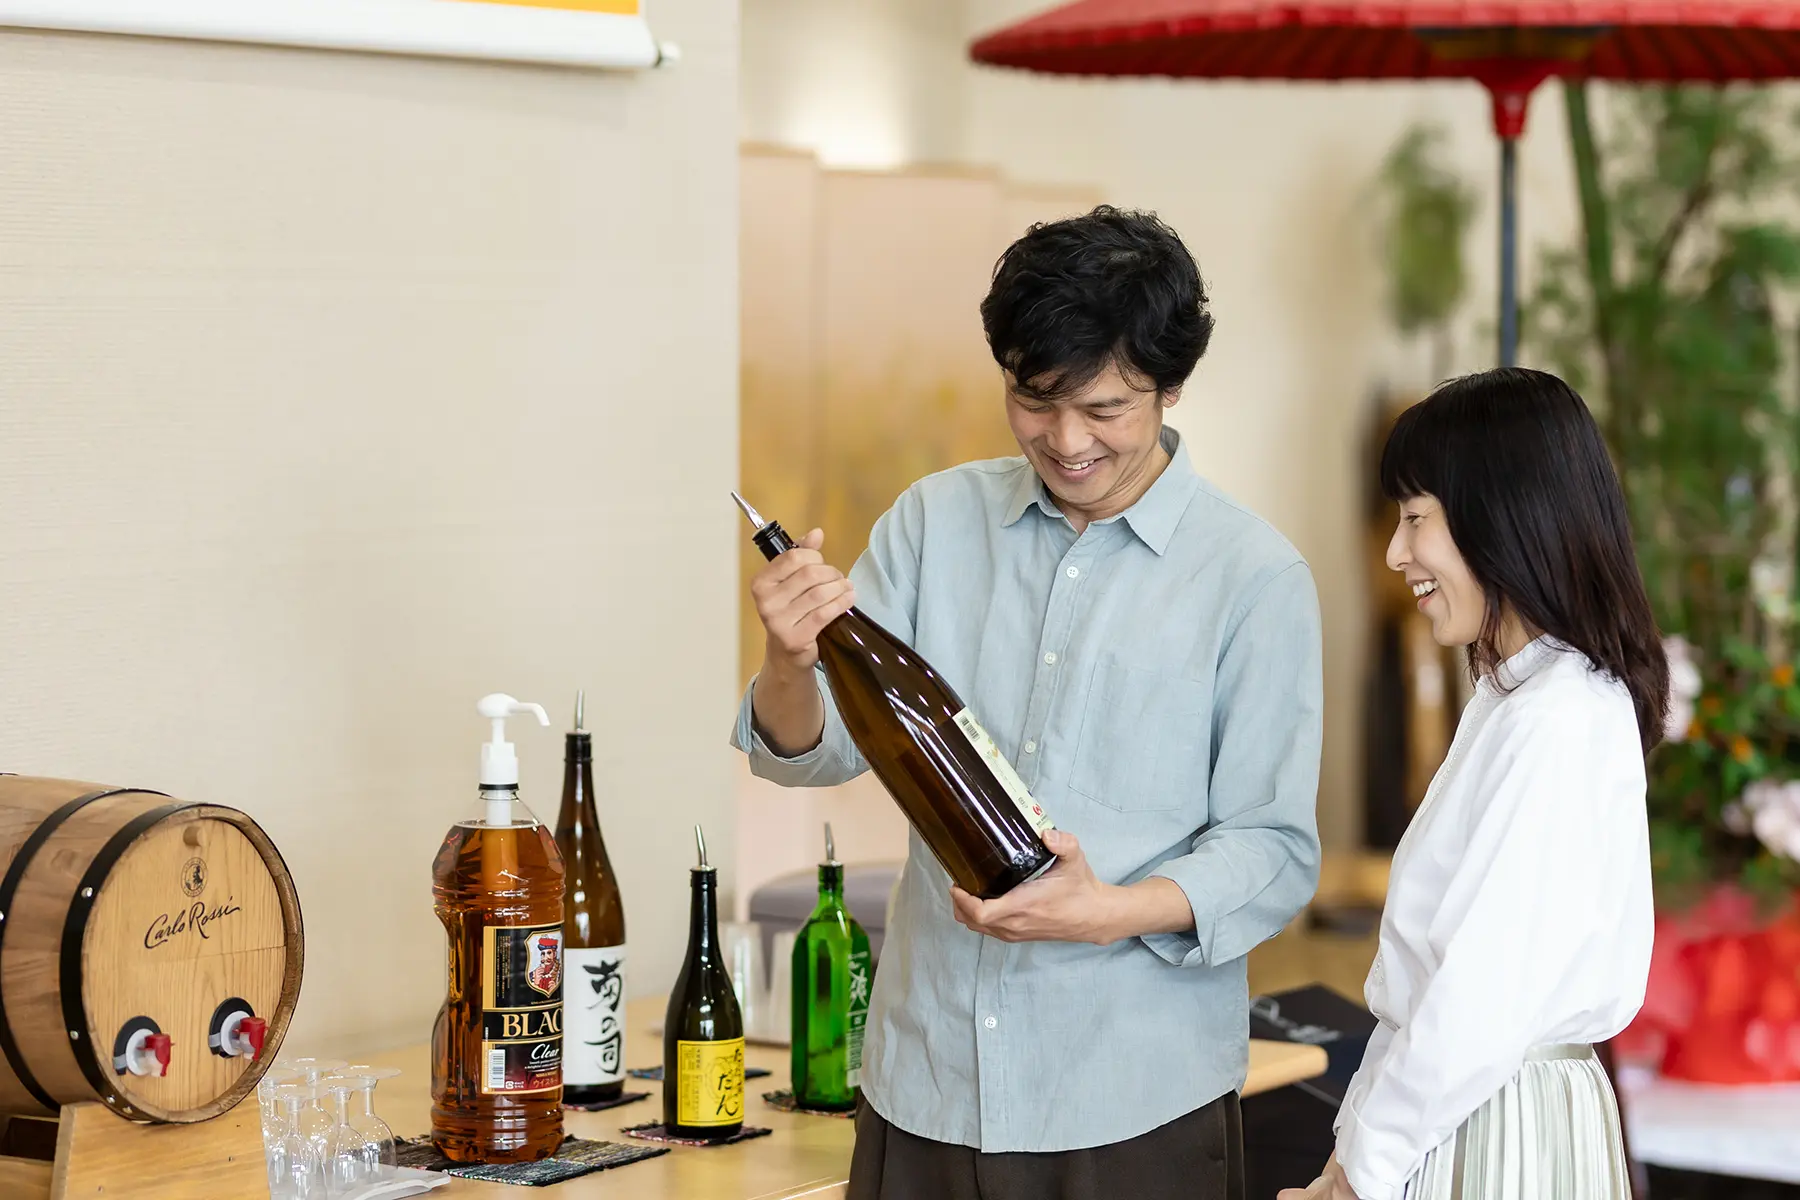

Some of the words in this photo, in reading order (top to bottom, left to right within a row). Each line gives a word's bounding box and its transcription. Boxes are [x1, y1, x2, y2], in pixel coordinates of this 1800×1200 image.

[144, 909, 185, 949] Carlo
[189, 896, 241, 940] Rossi
[531, 1043, 560, 1060] Clear
